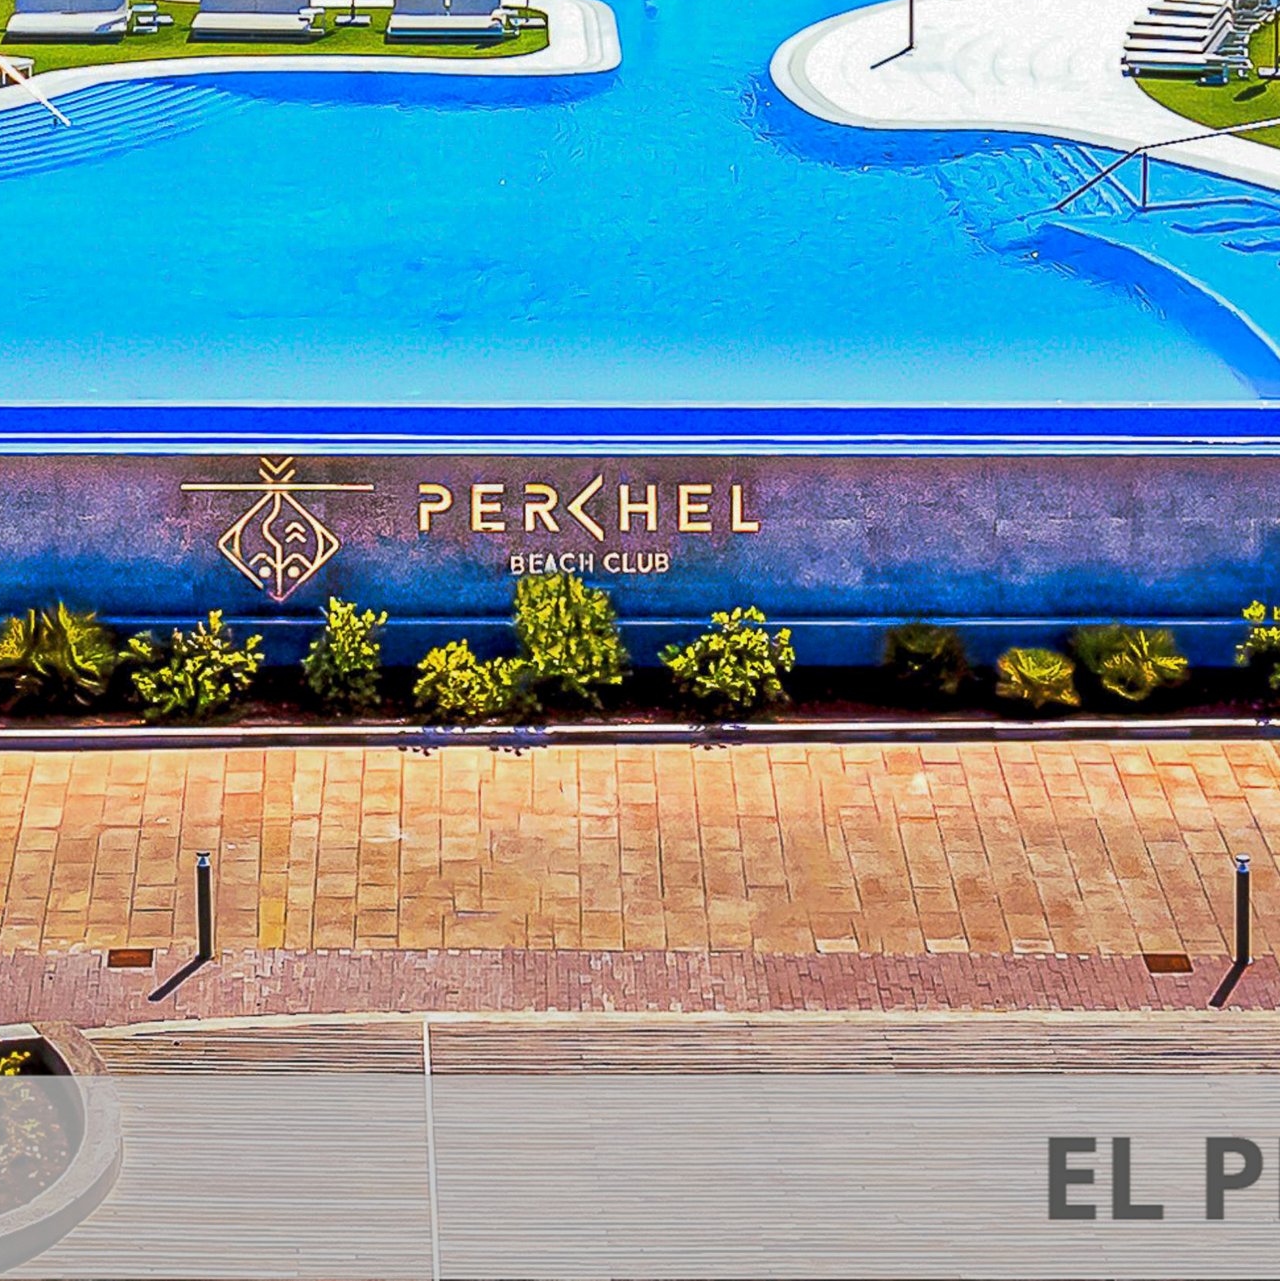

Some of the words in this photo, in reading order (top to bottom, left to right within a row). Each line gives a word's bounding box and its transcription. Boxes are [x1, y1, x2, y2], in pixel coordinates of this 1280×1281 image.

[418, 474, 761, 542] PERCHEL
[510, 552, 594, 575] BEACH
[602, 552, 669, 574] CLUB
